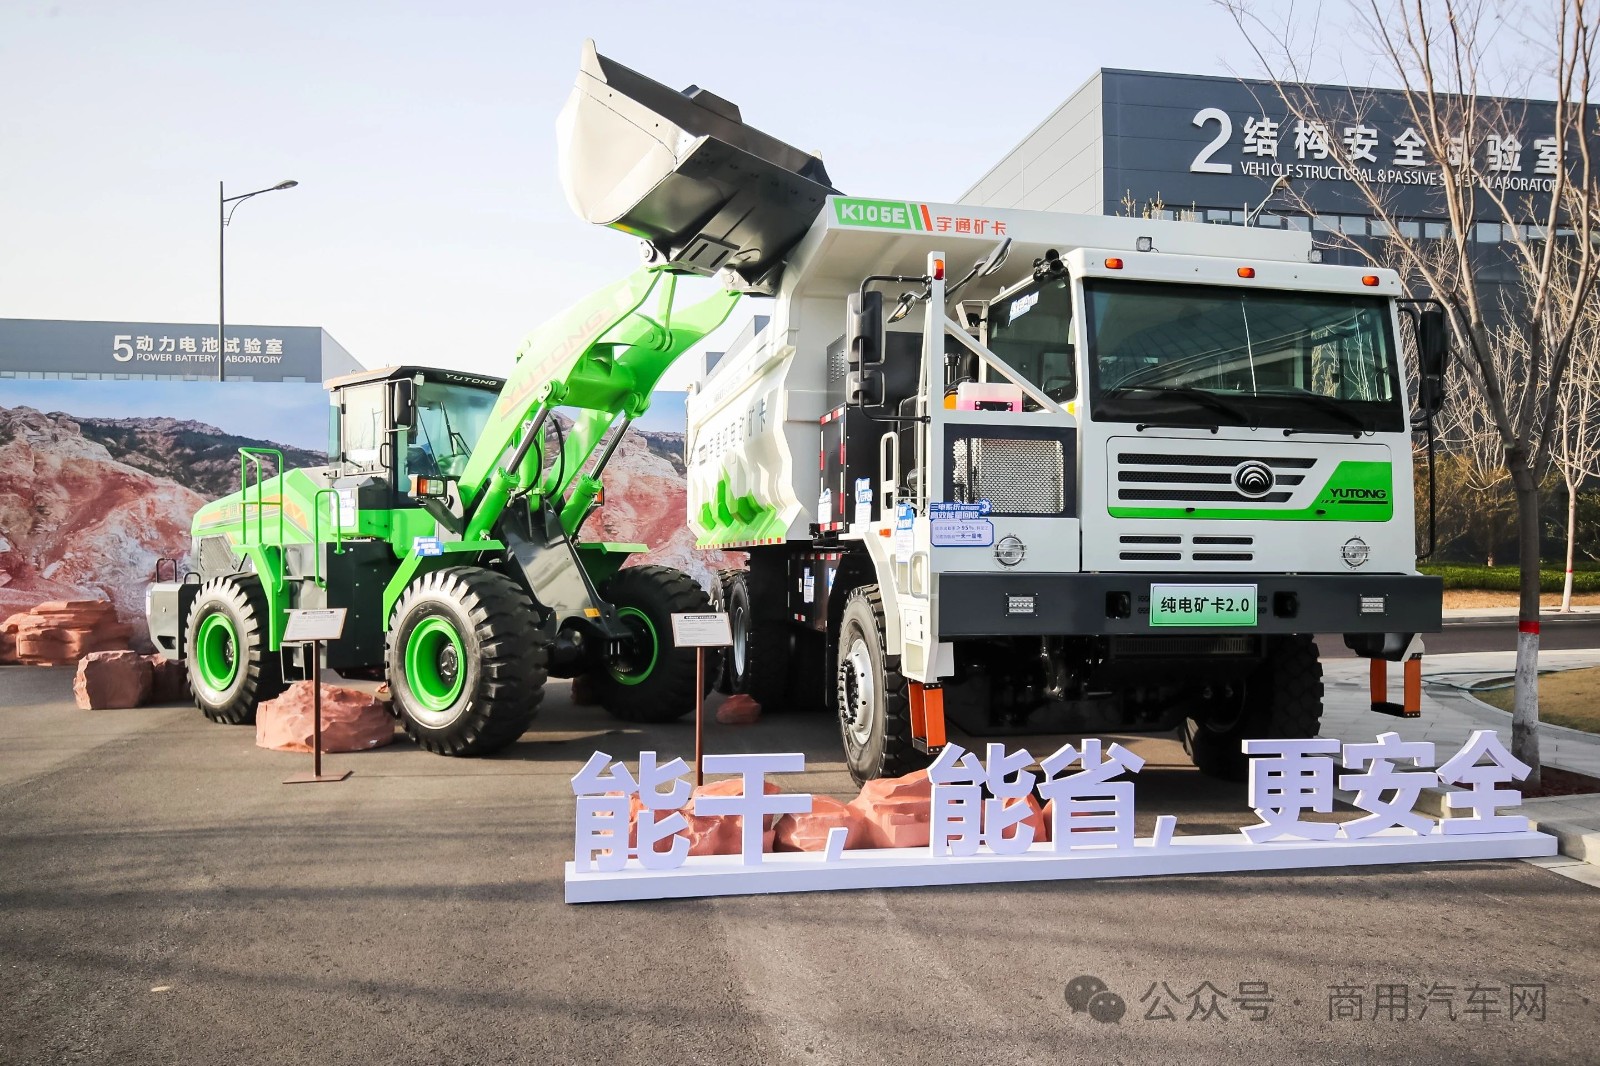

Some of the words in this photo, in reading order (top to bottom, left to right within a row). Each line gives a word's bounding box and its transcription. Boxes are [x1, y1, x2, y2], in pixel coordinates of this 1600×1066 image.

[1190, 107, 1233, 174] 2
[1240, 161, 1294, 178] VEHICLE
[1488, 175, 1558, 193] LABORATOR
[841, 203, 905, 224] K105E
[936, 216, 1007, 236] 宇通矿卡
[113, 334, 134, 362] 5
[136, 335, 283, 355] 动力电池试验室
[136, 353, 172, 362] POWER
[175, 354, 217, 363] BATTERY
[224, 355, 282, 364] ABORATORY
[445, 373, 497, 386] YUTONG
[1329, 487, 1387, 499] YUTONG
[1160, 596, 1250, 614] 纯电矿卡2.0
